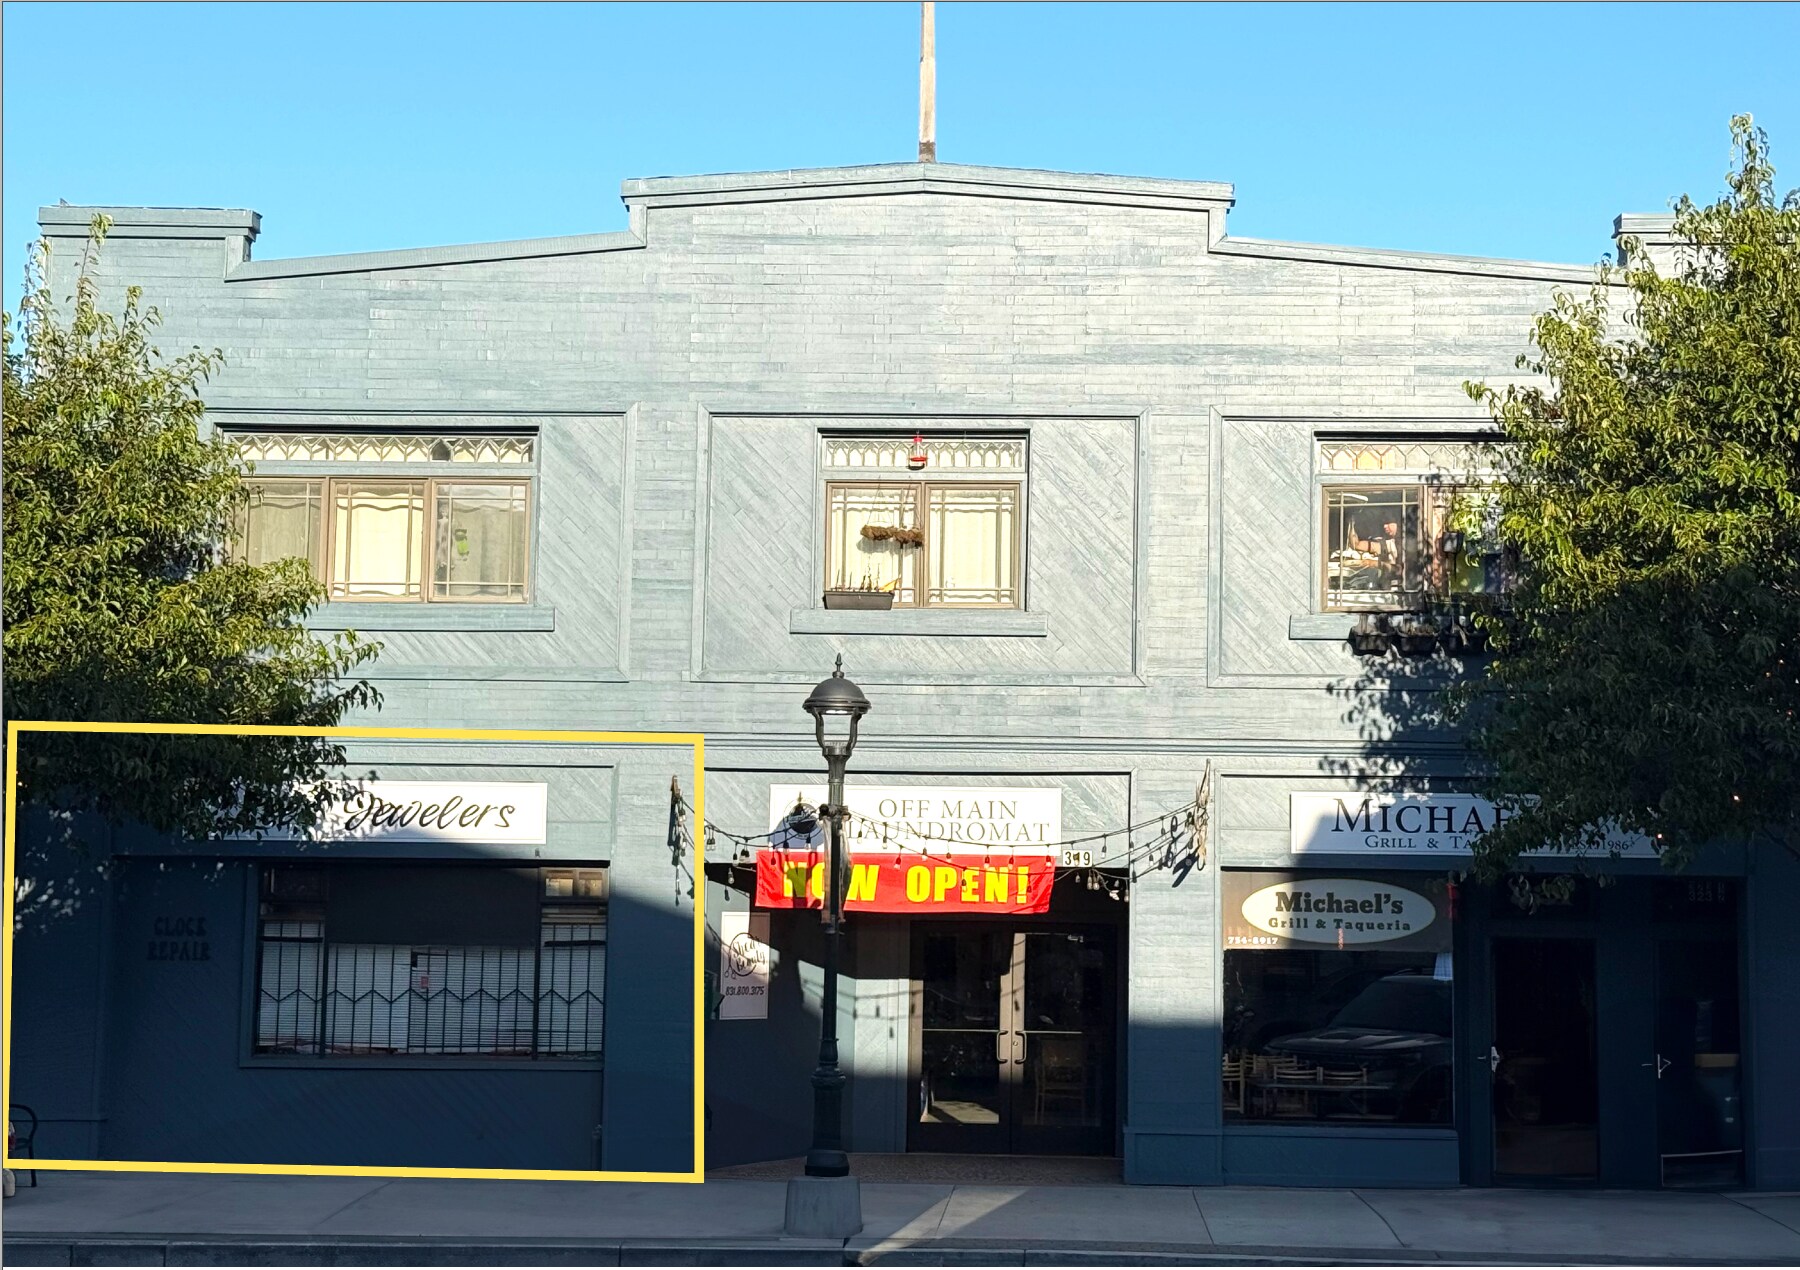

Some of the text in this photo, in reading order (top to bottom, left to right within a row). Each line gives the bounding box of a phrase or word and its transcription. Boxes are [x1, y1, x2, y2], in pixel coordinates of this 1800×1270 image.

[344, 790, 515, 831] Jewelers
[878, 799, 1017, 820] OFF MAIN
[847, 820, 1050, 842] LAUNDROMAT
[1365, 835, 1416, 849] GRILL
[1427, 836, 1440, 849] &
[906, 865, 1030, 904] OPEN!
[1275, 891, 1403, 915] Michael's
[154, 916, 206, 936] CLOCK
[1268, 918, 1412, 932] Grill & Taqueria
[147, 941, 210, 961] REPAIR
